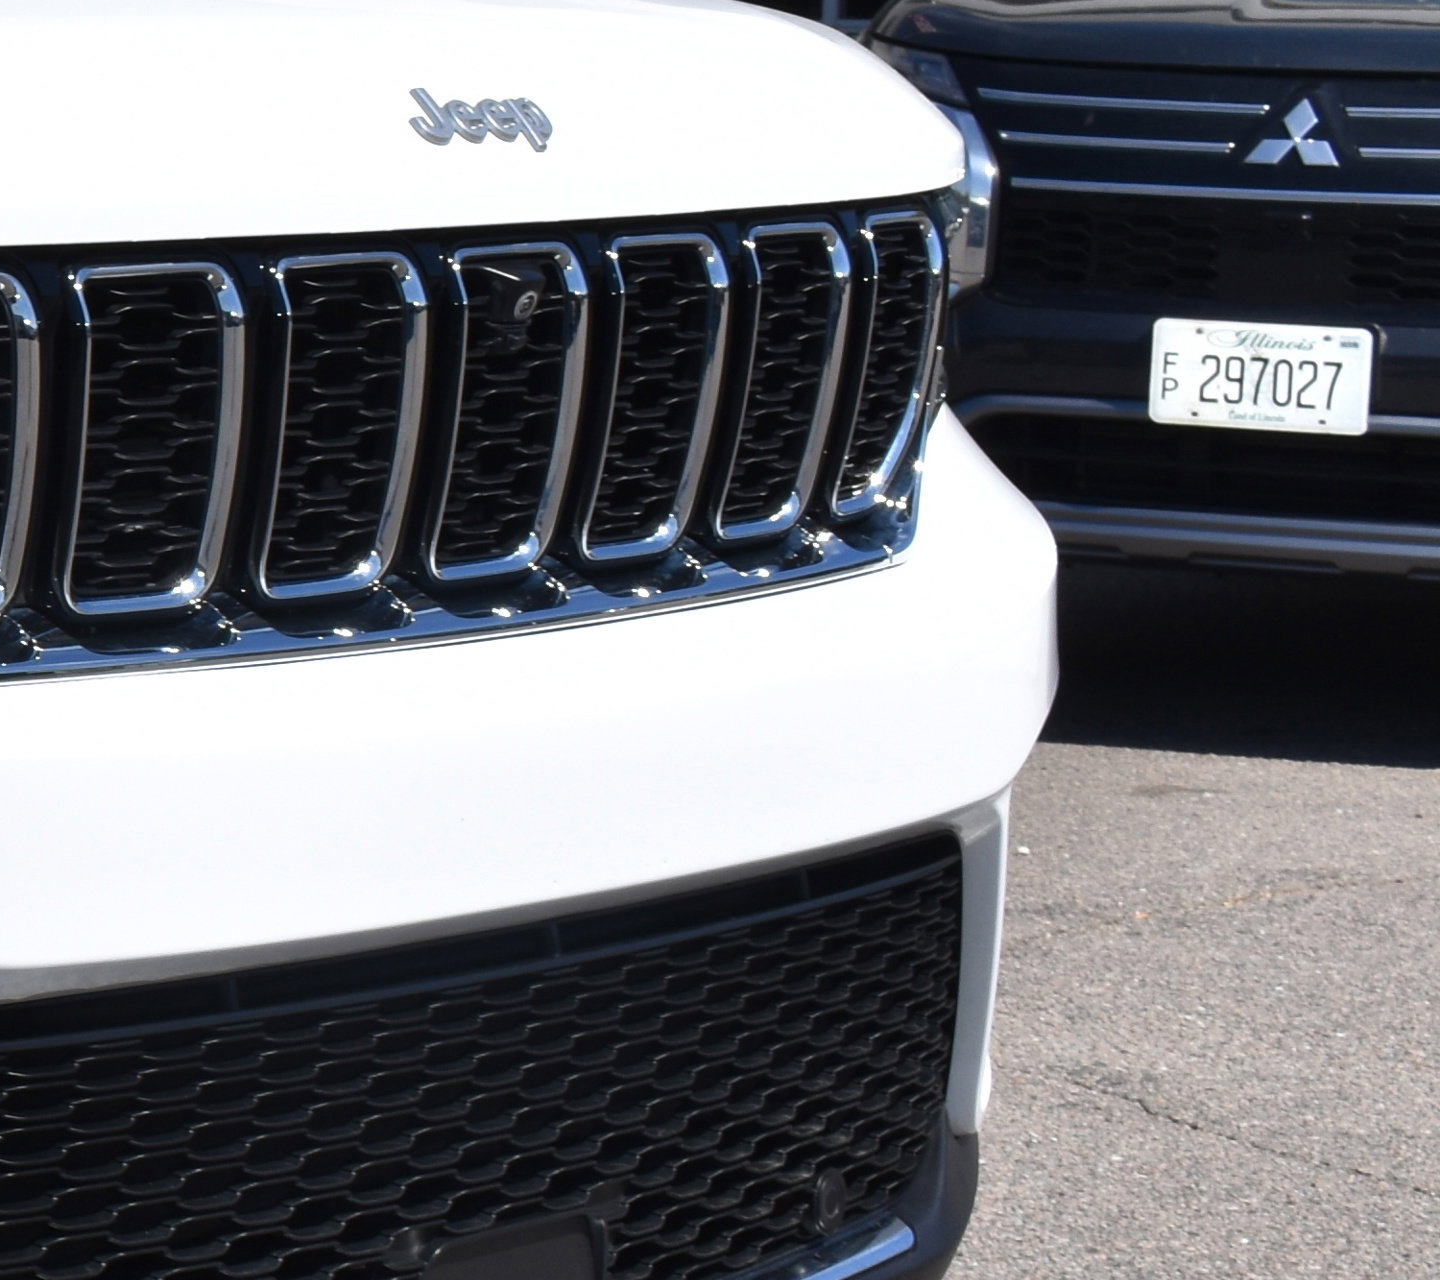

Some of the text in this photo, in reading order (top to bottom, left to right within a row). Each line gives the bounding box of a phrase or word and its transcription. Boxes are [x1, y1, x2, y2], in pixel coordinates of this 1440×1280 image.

[408, 87, 553, 153] Jeep
[1207, 328, 1317, 352] Illinois
[1199, 353, 1343, 411] 297027
